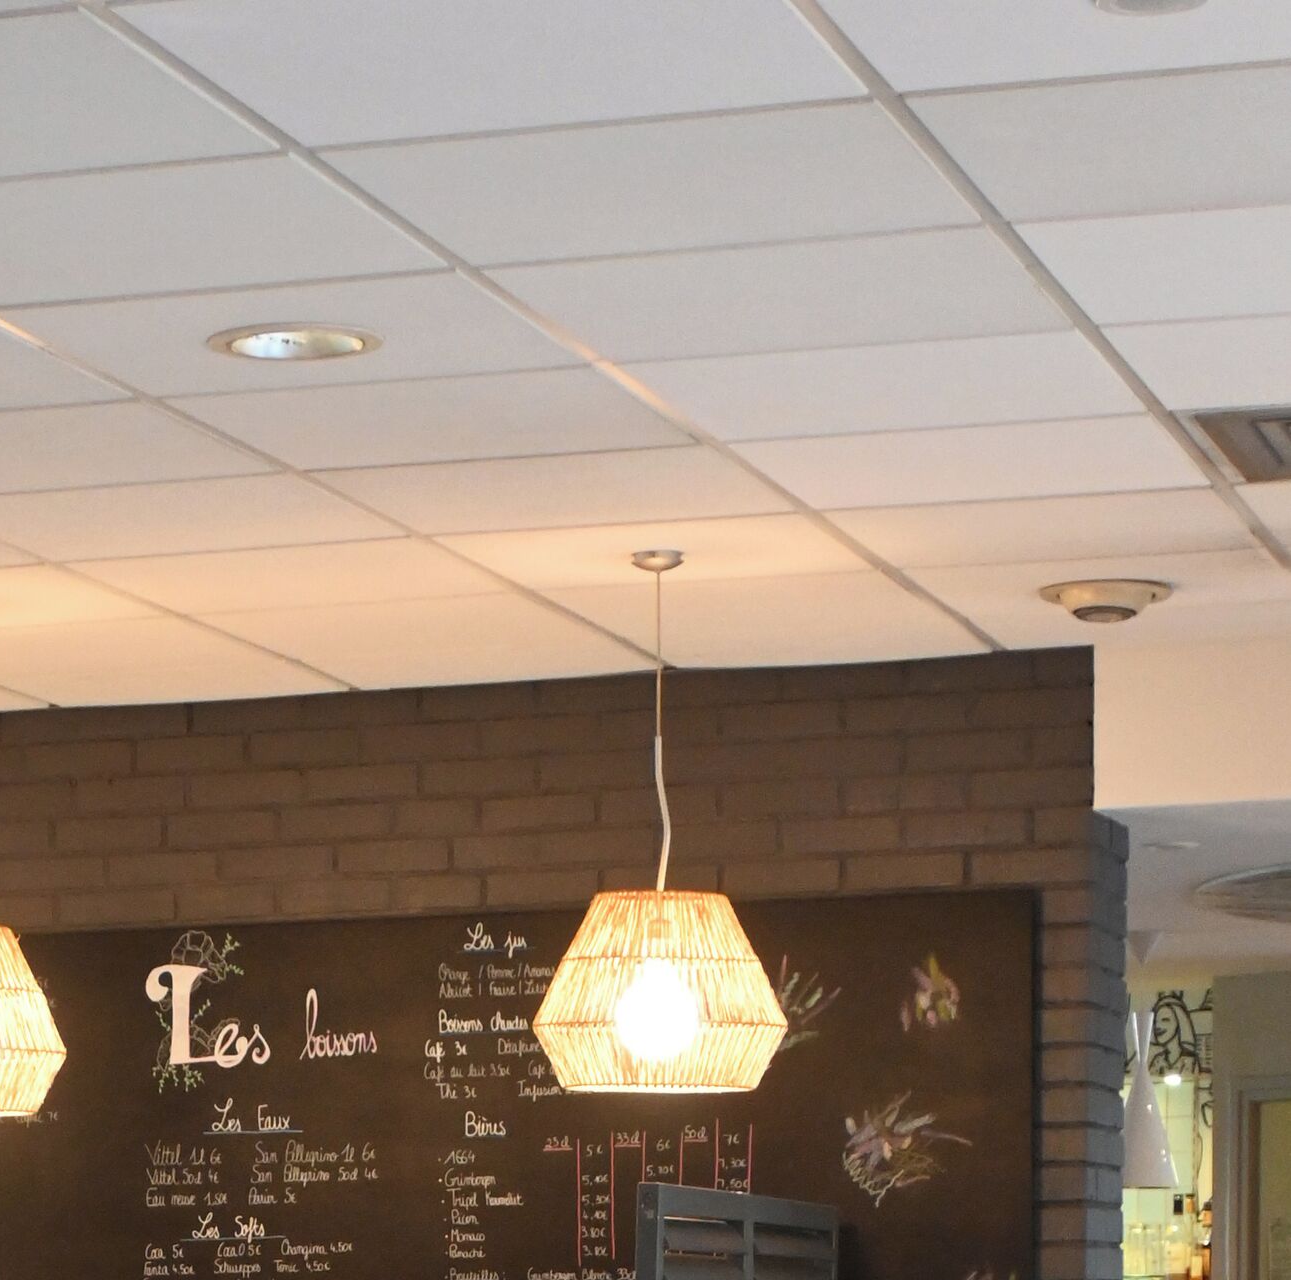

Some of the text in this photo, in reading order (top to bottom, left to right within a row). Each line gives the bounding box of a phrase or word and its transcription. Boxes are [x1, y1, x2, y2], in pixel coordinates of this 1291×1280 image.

[463, 921, 528, 958] Les jus
[145, 963, 378, 1068] Les boissons
[438, 1008, 484, 1034] Boissons
[424, 1039, 446, 1063] Café
[423, 1062, 446, 1083] Café
[212, 1098, 291, 1132] Les Eaux
[464, 1110, 507, 1138] Bières
[145, 1139, 182, 1166] Vittel
[254, 1141, 278, 1165] San
[284, 1140, 339, 1172] Pellegrino
[444, 1148, 476, 1165] 1664
[146, 1167, 176, 1185] Vittel
[251, 1166, 273, 1184] San
[146, 1186, 167, 1208] Eau
[192, 1211, 266, 1244] Les Softs
